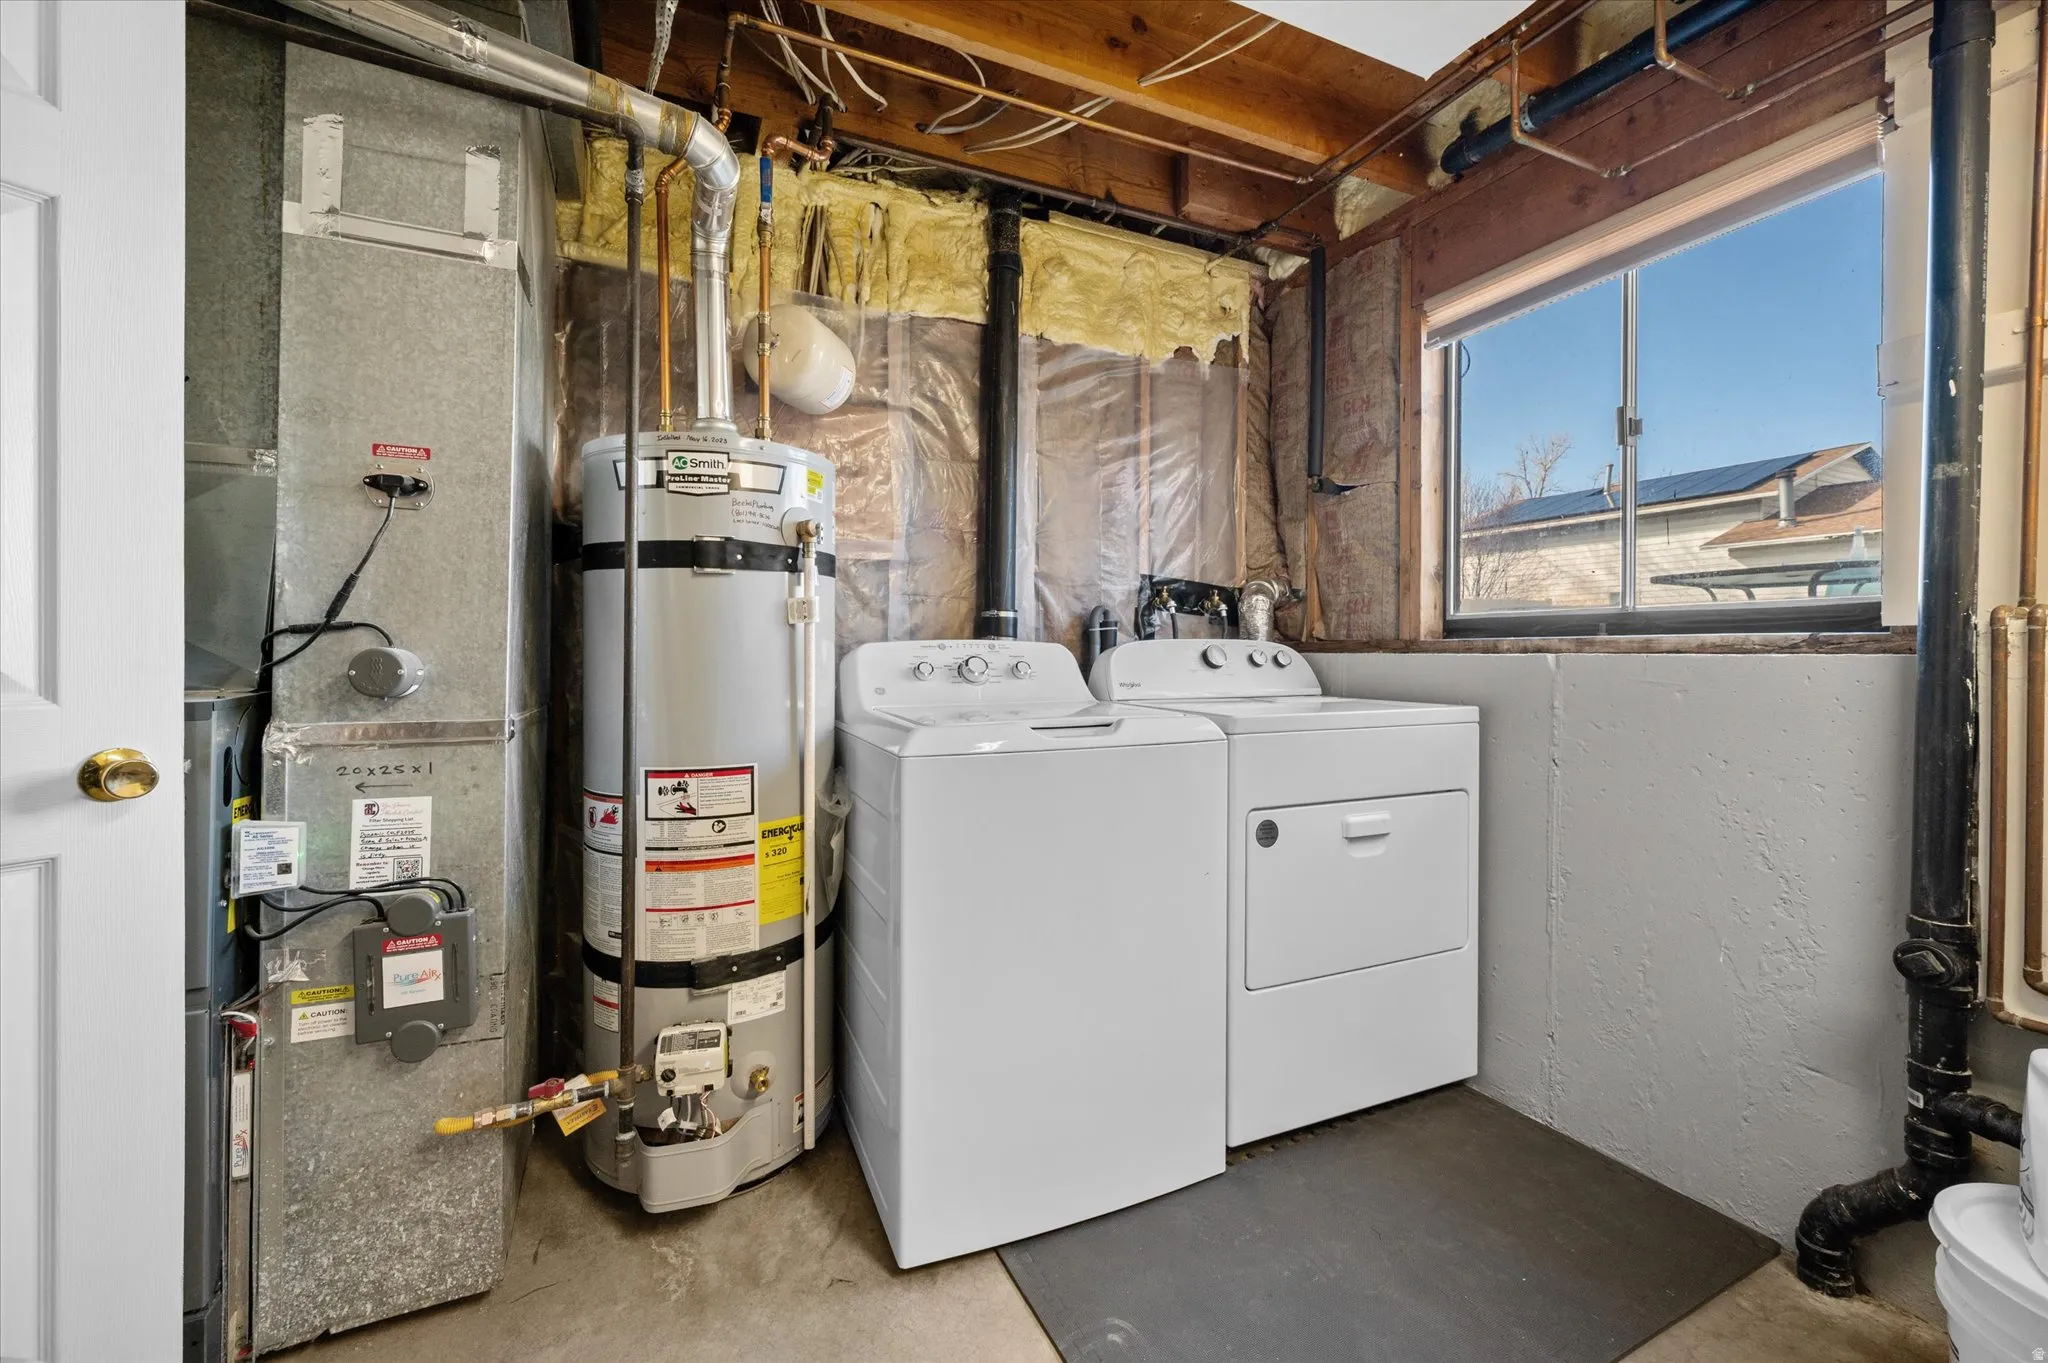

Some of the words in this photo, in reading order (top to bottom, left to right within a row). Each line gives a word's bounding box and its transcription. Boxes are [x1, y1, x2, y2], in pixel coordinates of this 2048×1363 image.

[386, 445, 418, 454] CAUTION
[690, 458, 726, 469] Smith
[1118, 682, 1142, 690] Whirlpool
[772, 846, 788, 857] 320
[396, 936, 428, 946] CAUTION
[393, 972, 418, 981] Pure
[310, 1008, 348, 1018] CAUTION:
[490, 1004, 498, 1033] COATING
[234, 1148, 242, 1168] Pure
